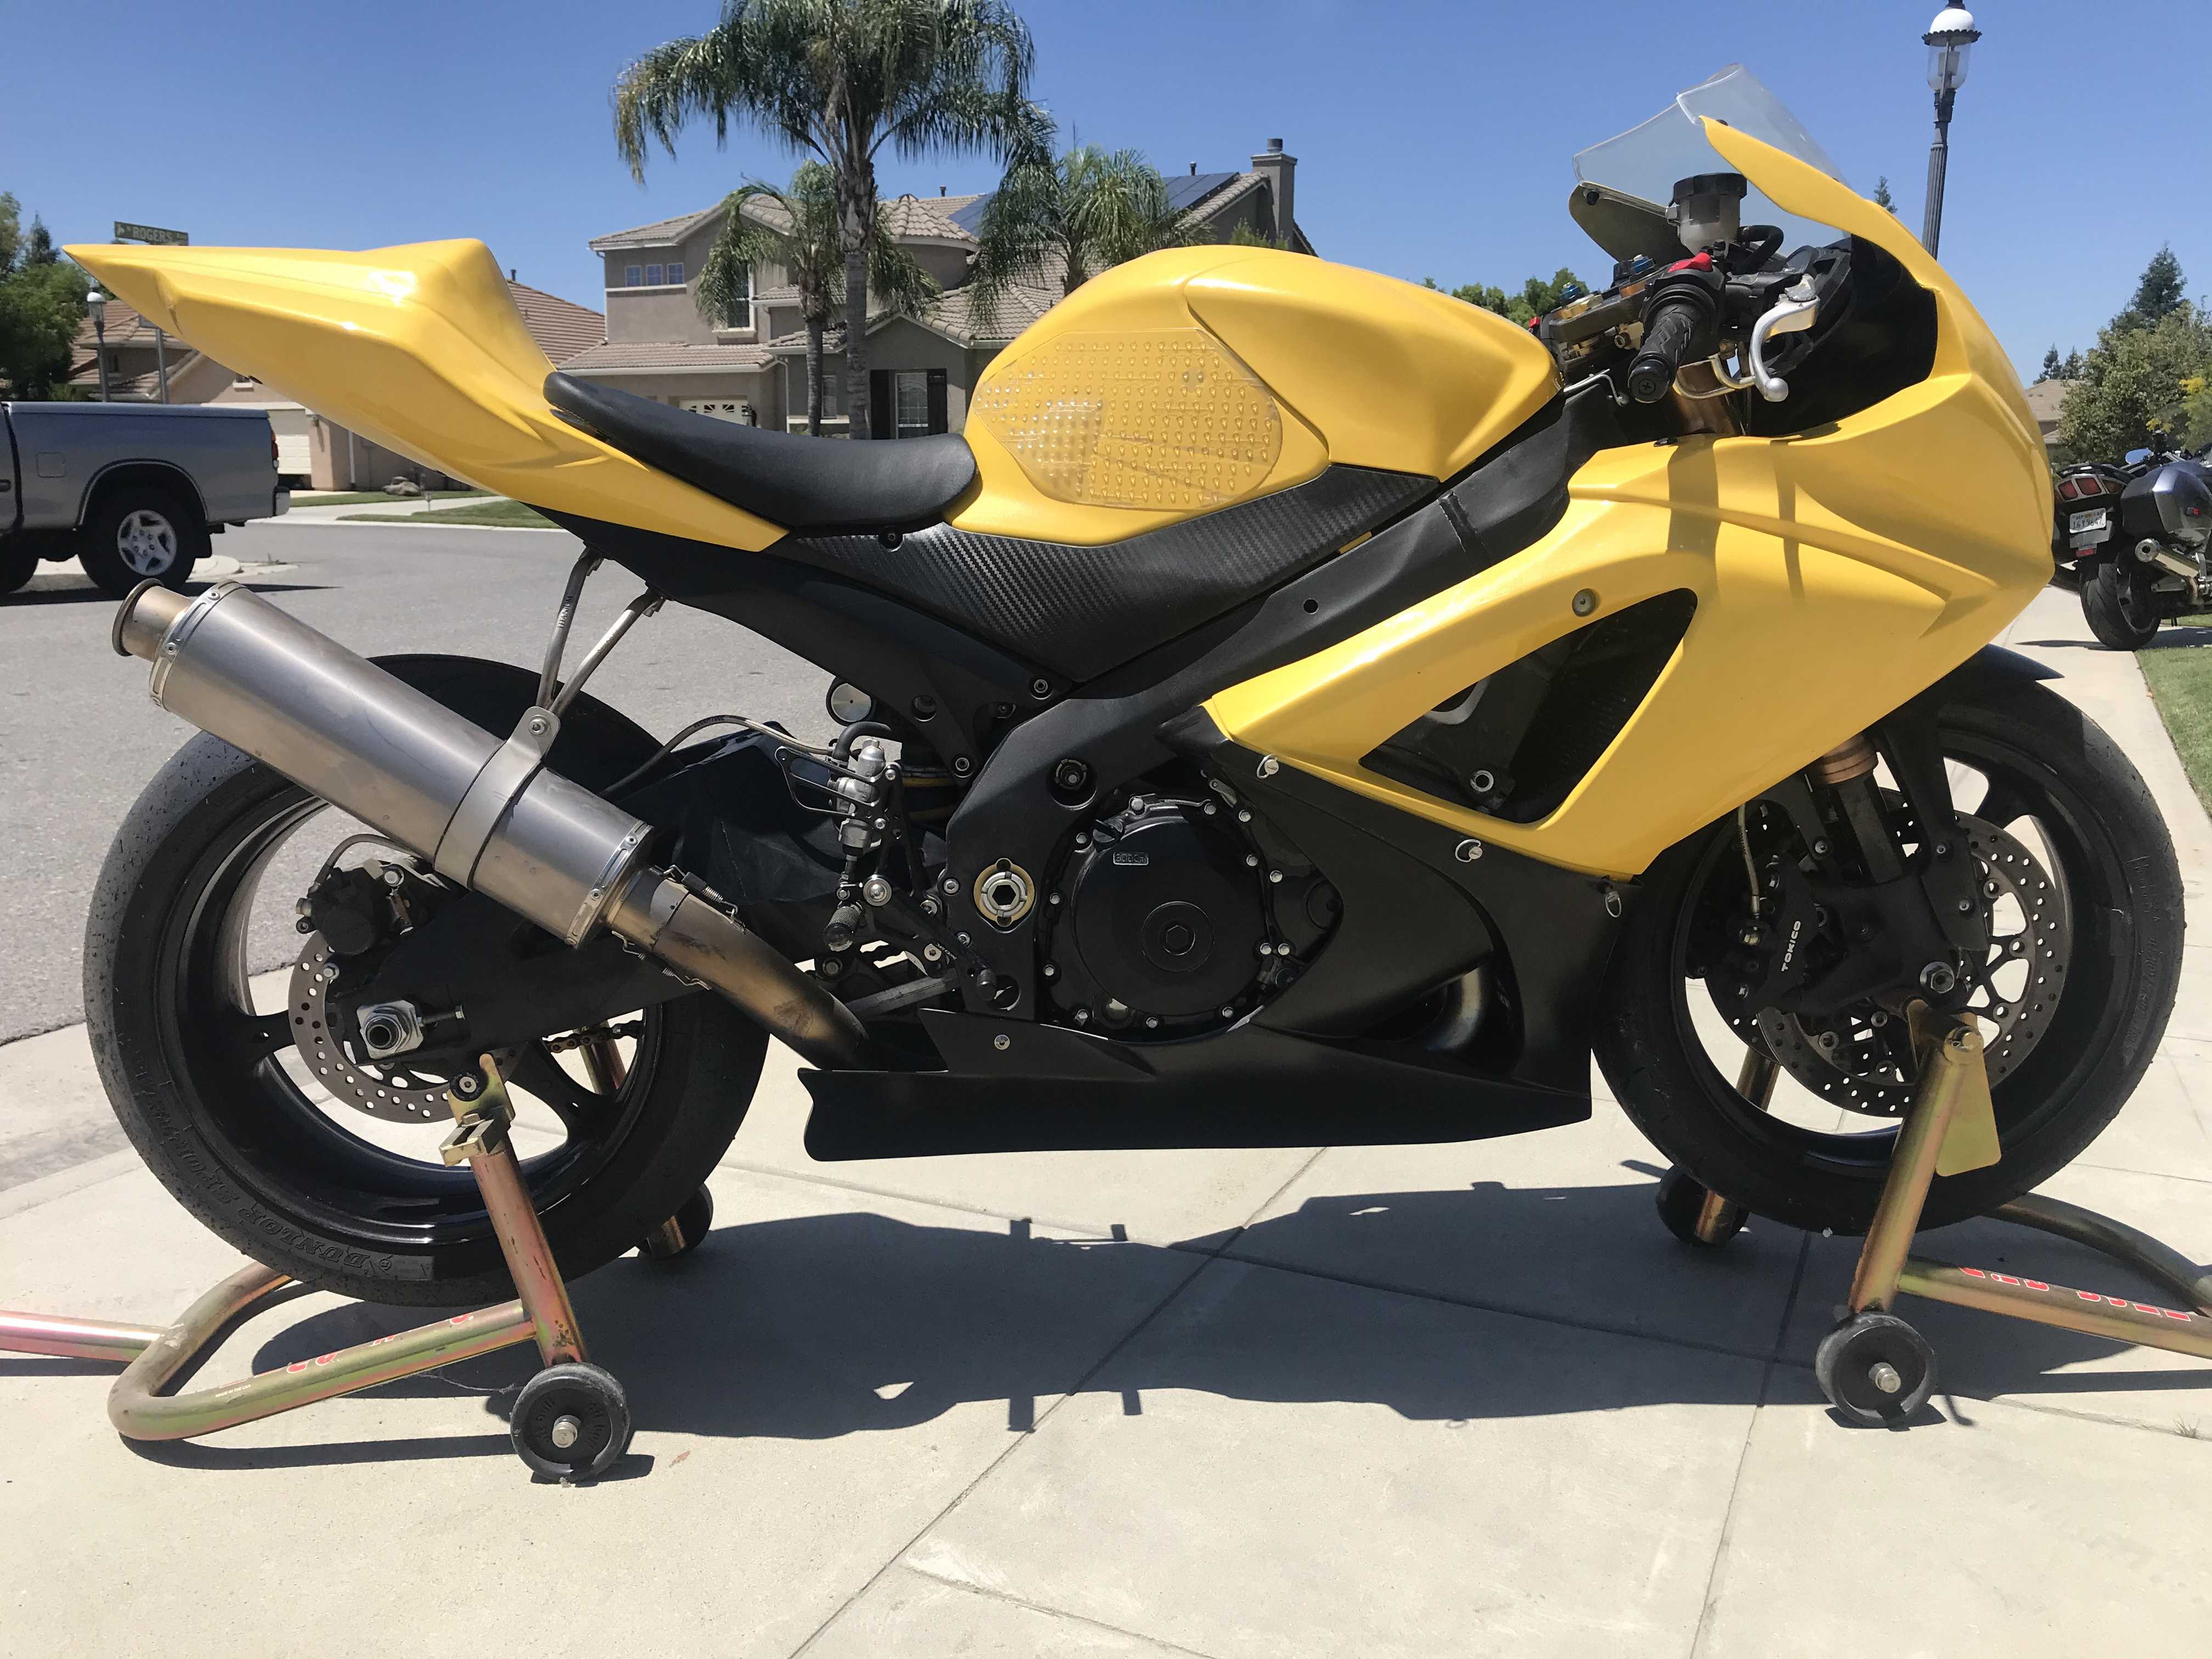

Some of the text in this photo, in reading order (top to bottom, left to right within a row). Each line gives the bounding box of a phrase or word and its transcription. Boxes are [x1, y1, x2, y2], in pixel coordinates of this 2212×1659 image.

[133, 226, 173, 242] ROGERS
[557, 596, 573, 629] TITANIUM
[1781, 921, 1801, 972] TOKICO
[238, 1206, 371, 1268] DUNLOP
